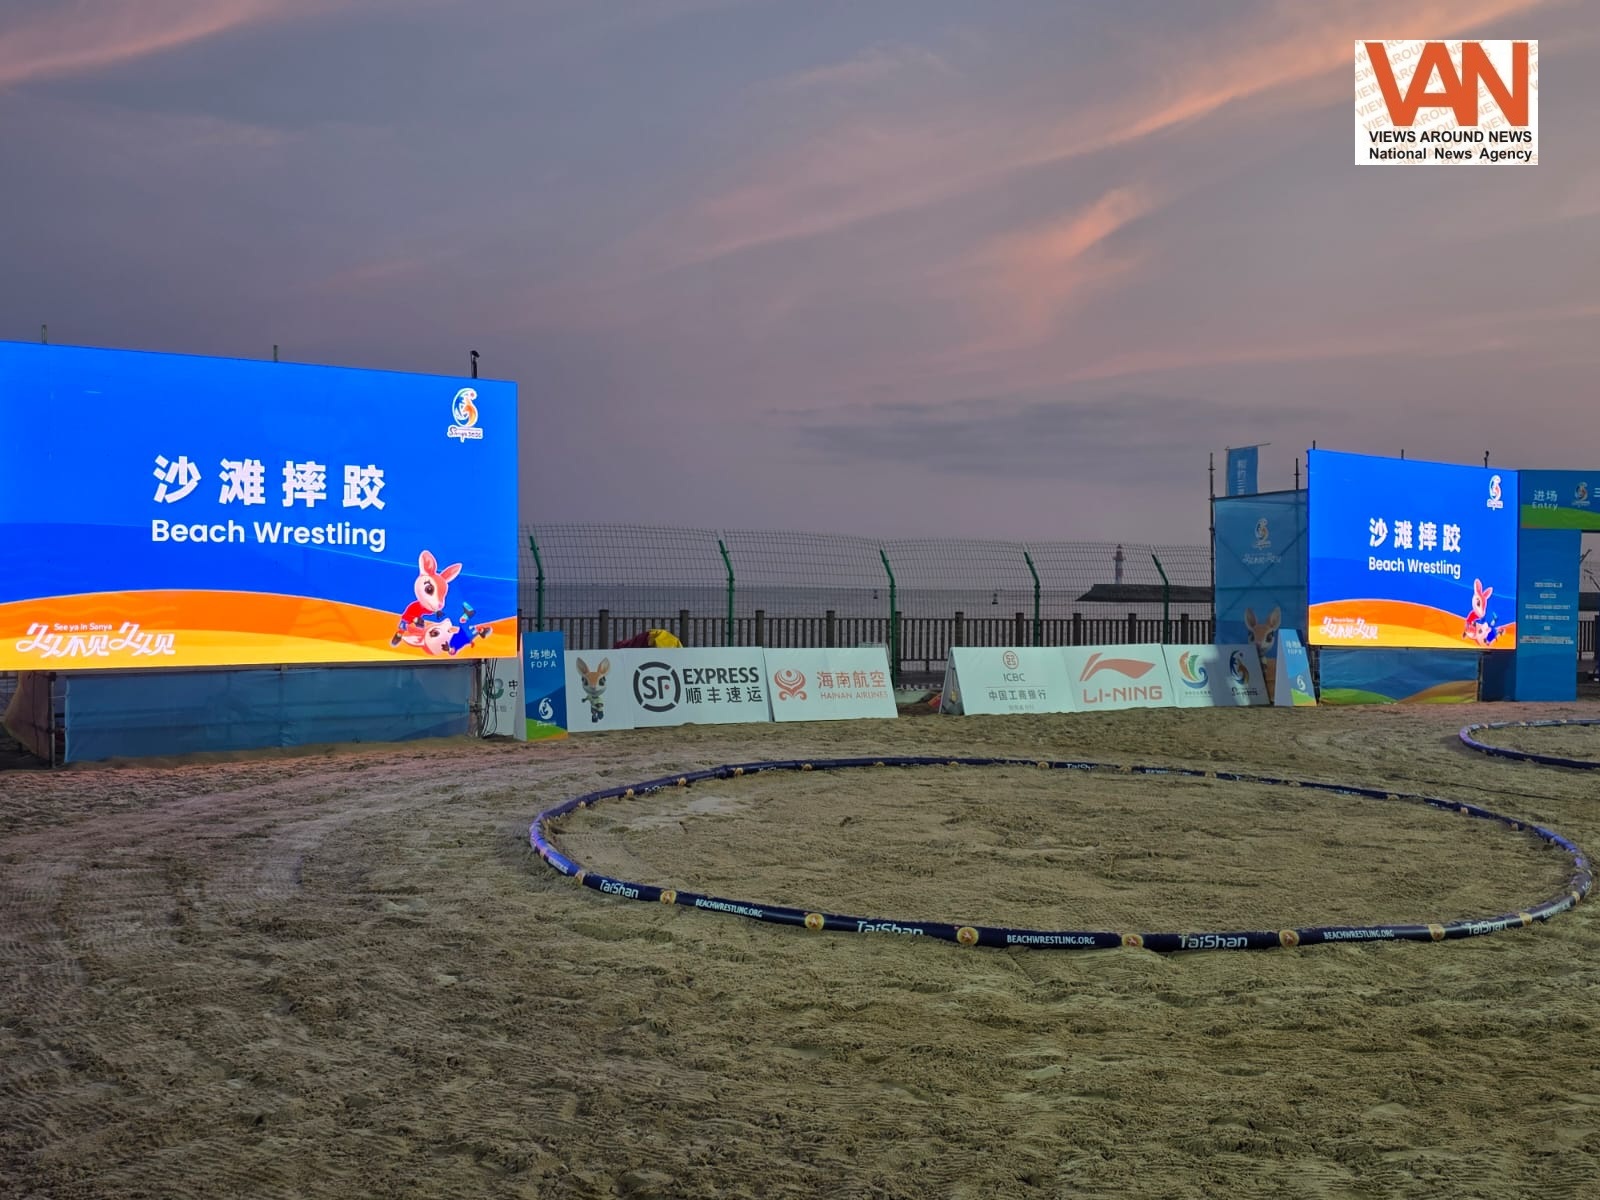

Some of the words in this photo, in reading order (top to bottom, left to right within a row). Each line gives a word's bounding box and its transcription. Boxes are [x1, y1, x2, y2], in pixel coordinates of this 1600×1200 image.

[153, 455, 386, 510] 沙滩摔跤
[1533, 489, 1558, 502] 进场
[1531, 502, 1558, 511] Entry
[152, 519, 246, 543] Beach
[253, 521, 386, 553] Wrestling
[1369, 517, 1461, 553] 沙滩摔跤
[1368, 556, 1405, 573] Beach
[1407, 558, 1461, 580] Wrestling
[54, 623, 68, 631] See
[69, 624, 79, 632] ya
[89, 622, 112, 632] Sanya
[683, 667, 760, 685] EXPRESS
[817, 670, 886, 688] 海南航空
[1003, 673, 1026, 683] ICBC
[642, 674, 671, 700] SF
[685, 686, 763, 704] 顺丰速运
[821, 691, 853, 700] HAINAN
[1083, 686, 1163, 704] LI-NING
[600, 879, 639, 899] TaiShan
[695, 898, 763, 918] BEACHWRESTLING.ORG
[1006, 934, 1096, 945] BEACHWRESTLING.ORG
[1179, 934, 1248, 949] TaiShan
[1323, 928, 1395, 940] BEACHWRESTLING.ORG
